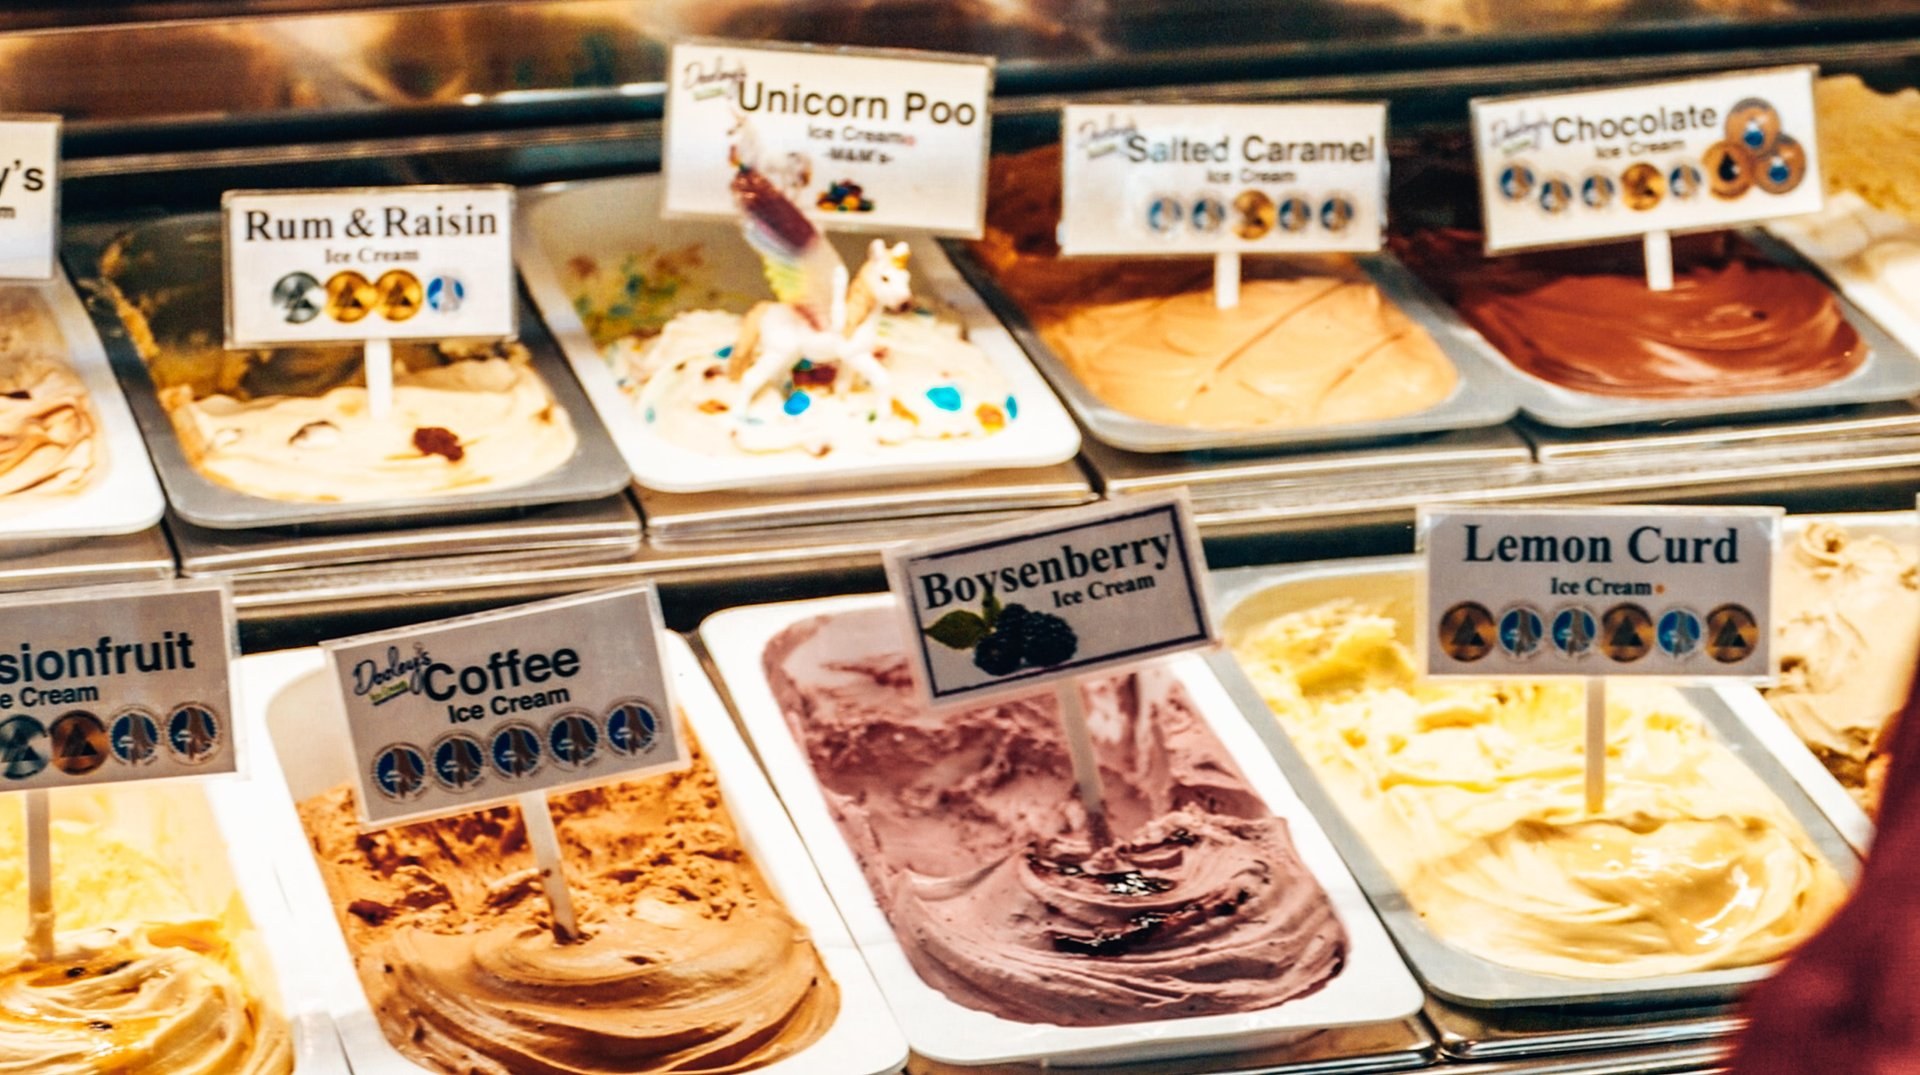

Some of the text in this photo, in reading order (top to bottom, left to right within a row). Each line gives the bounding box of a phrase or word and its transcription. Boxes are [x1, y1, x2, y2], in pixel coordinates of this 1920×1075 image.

[738, 81, 888, 120] Unicorn
[904, 93, 976, 126] Poo
[807, 124, 903, 143] Ice Cream
[1552, 105, 1718, 144] Chocolate
[1127, 135, 1229, 163] Salted
[1242, 135, 1376, 163] Caramel
[1596, 139, 1686, 159] Ice Cream
[1207, 169, 1297, 184] Ice Cream
[244, 204, 497, 241] Rum & Raisin
[325, 247, 420, 264] Ice Cream
[1463, 524, 1739, 564] Lemon Curd
[920, 532, 1172, 610] Boysenberry
[1551, 576, 1652, 595] Ice Cream
[1053, 575, 1156, 608] Ice Cream
[0, 631, 196, 685] sionfruit
[422, 648, 581, 702] Coffee
[20, 685, 99, 708] Cream
[448, 688, 570, 724] Ice Cream
